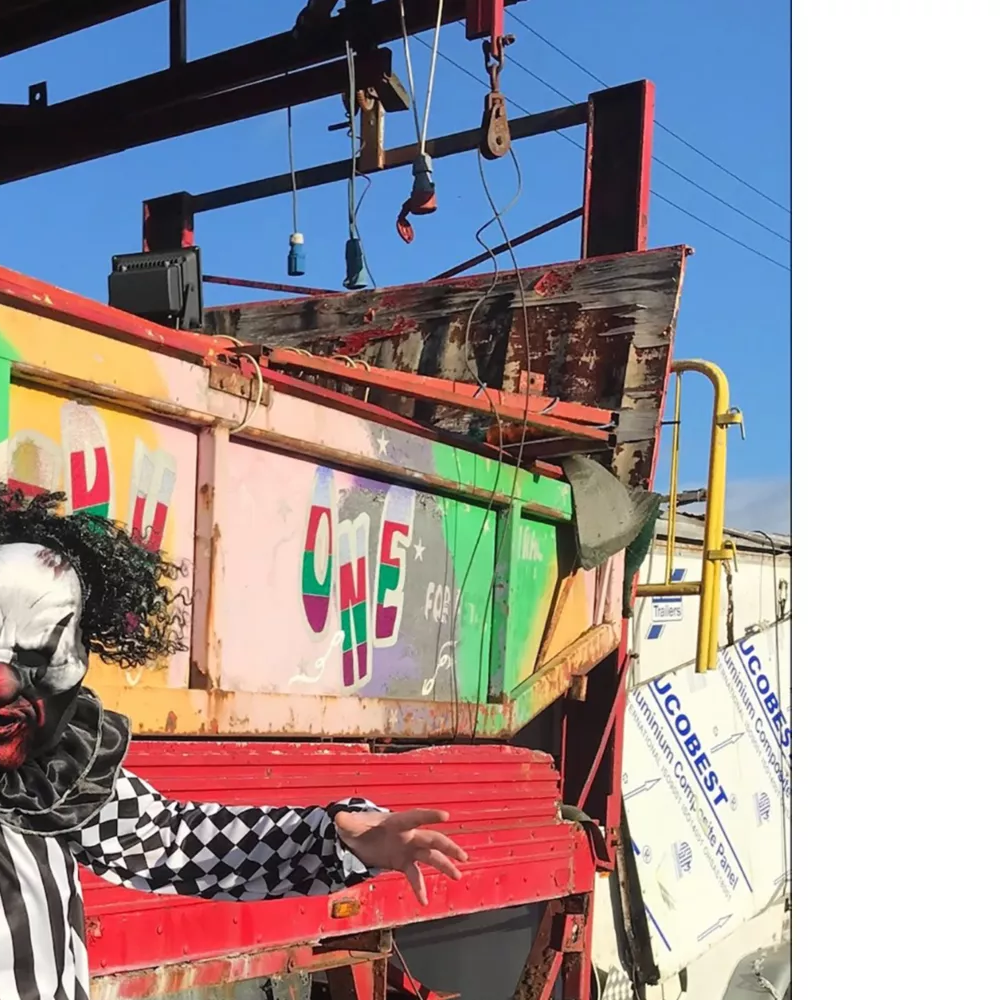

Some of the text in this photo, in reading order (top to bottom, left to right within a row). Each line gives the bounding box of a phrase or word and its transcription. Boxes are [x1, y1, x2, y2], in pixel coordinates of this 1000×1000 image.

[299, 465, 416, 690] ONE
[424, 581, 452, 624] FOR
[653, 604, 682, 618] Trailers
[716, 842, 739, 891] Panel
